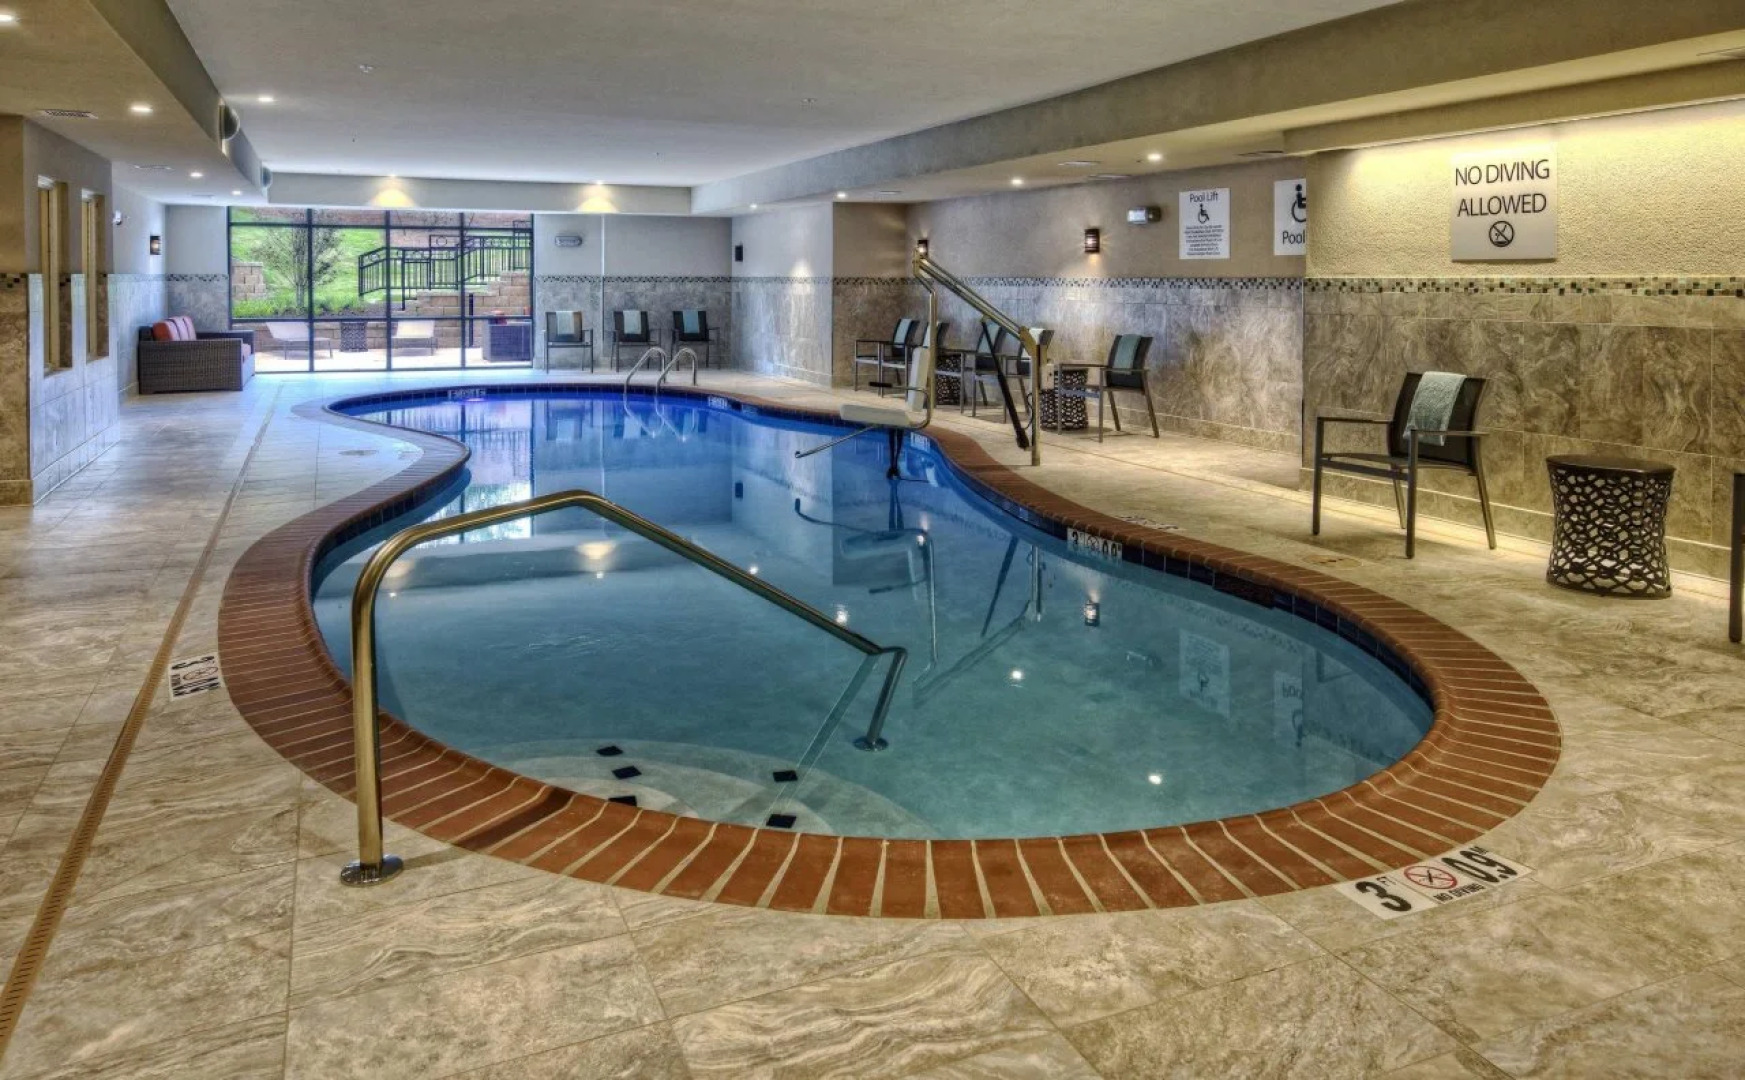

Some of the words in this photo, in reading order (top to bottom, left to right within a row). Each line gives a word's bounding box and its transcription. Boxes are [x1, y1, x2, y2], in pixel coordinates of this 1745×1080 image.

[1455, 165, 1482, 186] NO
[1486, 159, 1550, 184] DIVING
[1189, 192, 1205, 203] Pool
[1206, 191, 1219, 202] Lift
[1457, 193, 1547, 217] ALLOWED
[1282, 230, 1306, 245] Pool
[1355, 880, 1412, 912] 3
[1433, 892, 1454, 902] NO
[1448, 883, 1487, 898] DIVING
